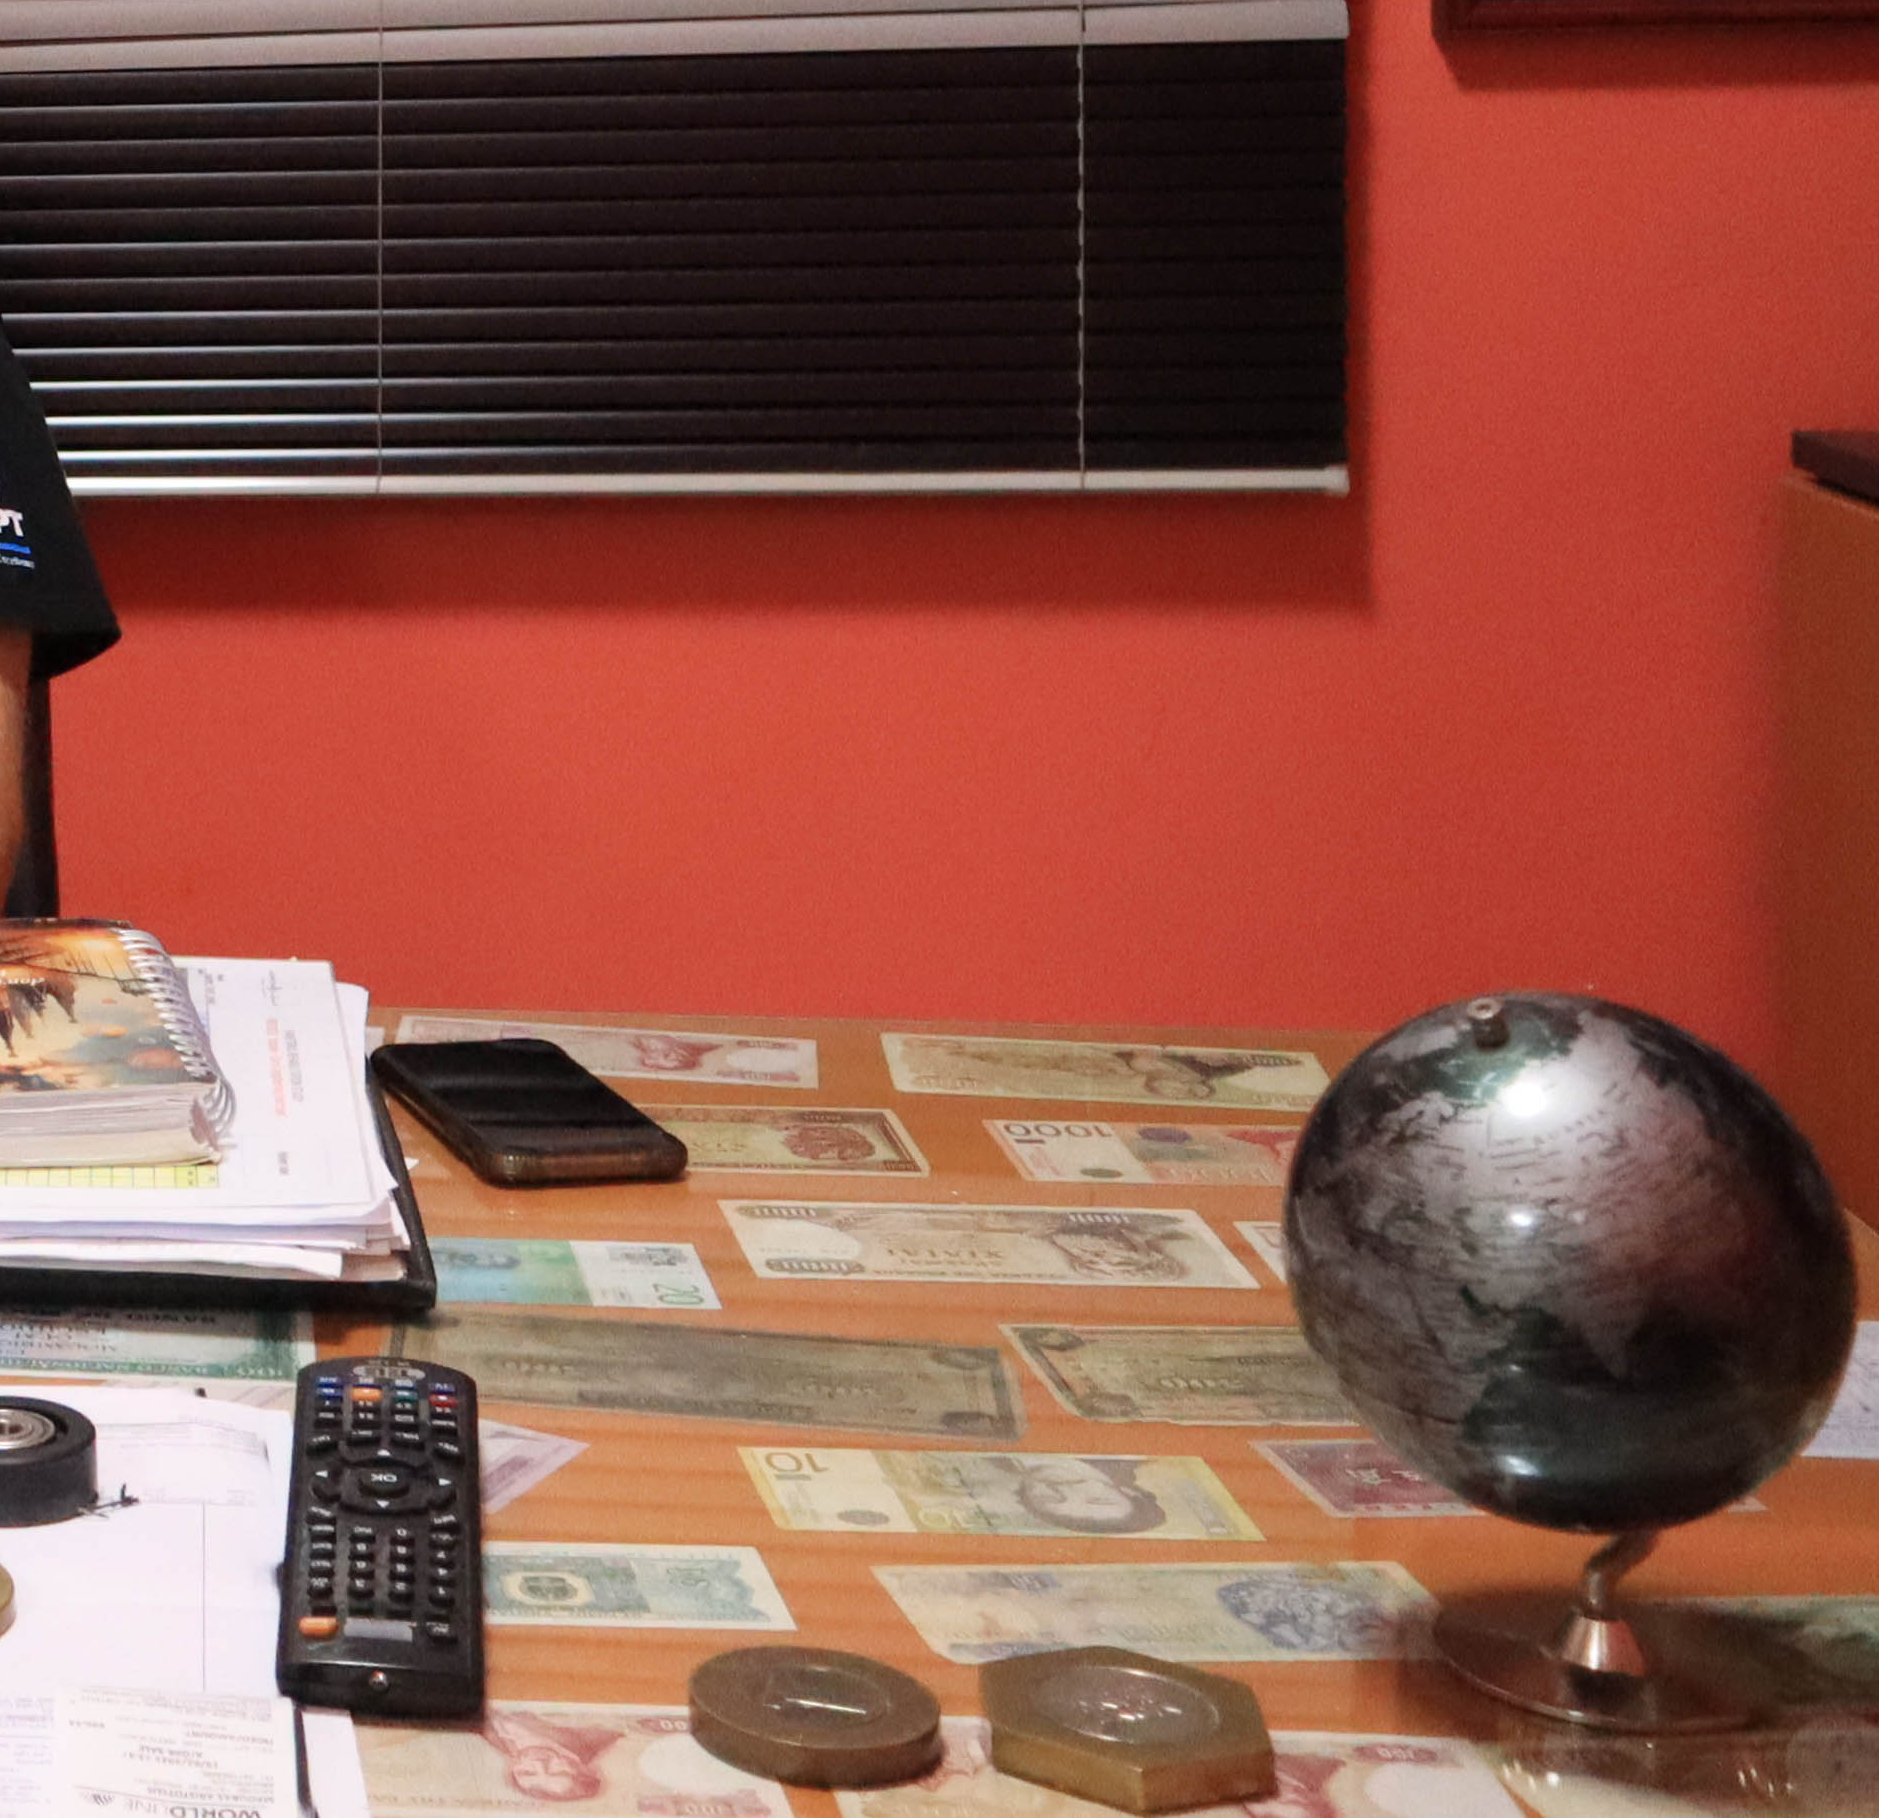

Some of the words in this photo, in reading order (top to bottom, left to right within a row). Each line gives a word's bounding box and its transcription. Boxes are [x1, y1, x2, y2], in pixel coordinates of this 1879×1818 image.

[1003, 1120, 1113, 1139] 1000
[762, 1450, 830, 1475] 10
[370, 1473, 398, 1482] OK
